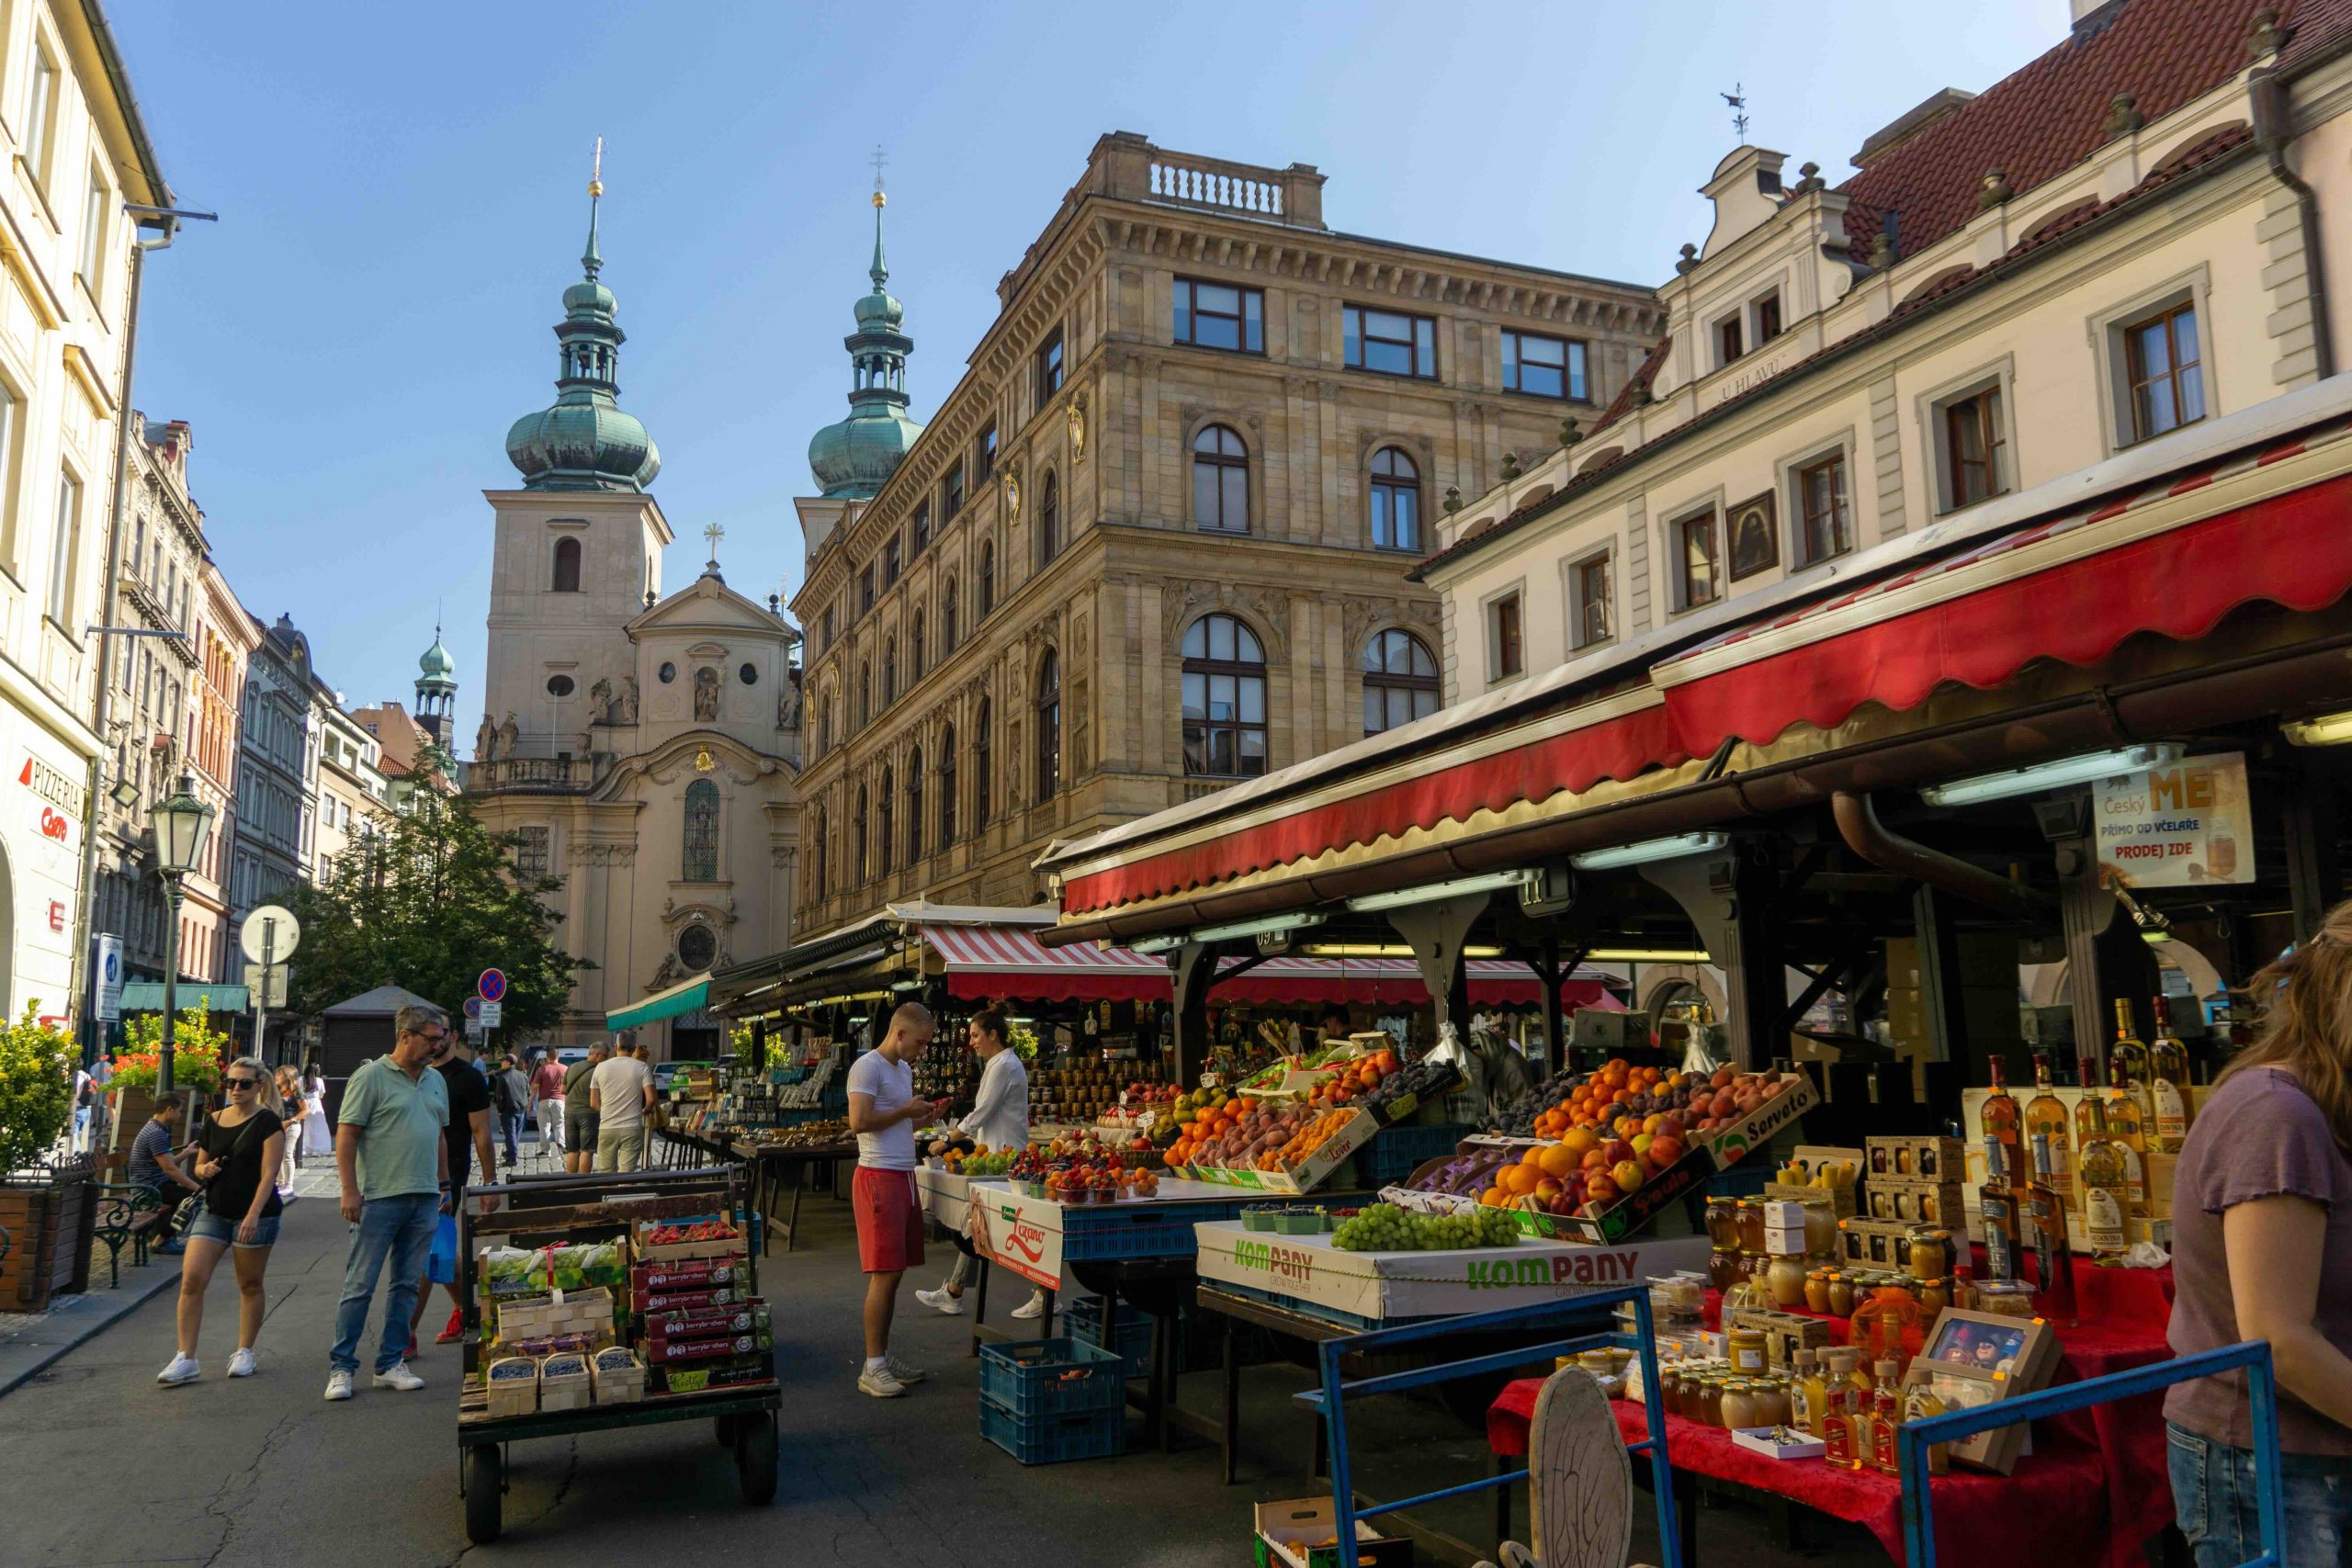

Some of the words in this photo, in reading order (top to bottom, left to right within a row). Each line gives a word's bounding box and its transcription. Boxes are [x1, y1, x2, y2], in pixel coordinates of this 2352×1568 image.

[33, 761, 80, 817] PIZZERIA
[2104, 795, 2145, 815] Český
[2147, 766, 2227, 812] ME
[2100, 821, 2133, 836] PŘÍMO
[2137, 823, 2152, 834] OD
[2155, 818, 2200, 832] VČELAŘE
[2116, 843, 2164, 860] PRODEJ
[2168, 842, 2193, 856] ZDE
[1747, 1091, 1808, 1141] Serveto
[1270, 1274, 1286, 1287] GROW
[1555, 1285, 1586, 1298] GROW
[669, 1371, 707, 1391] Prestige
